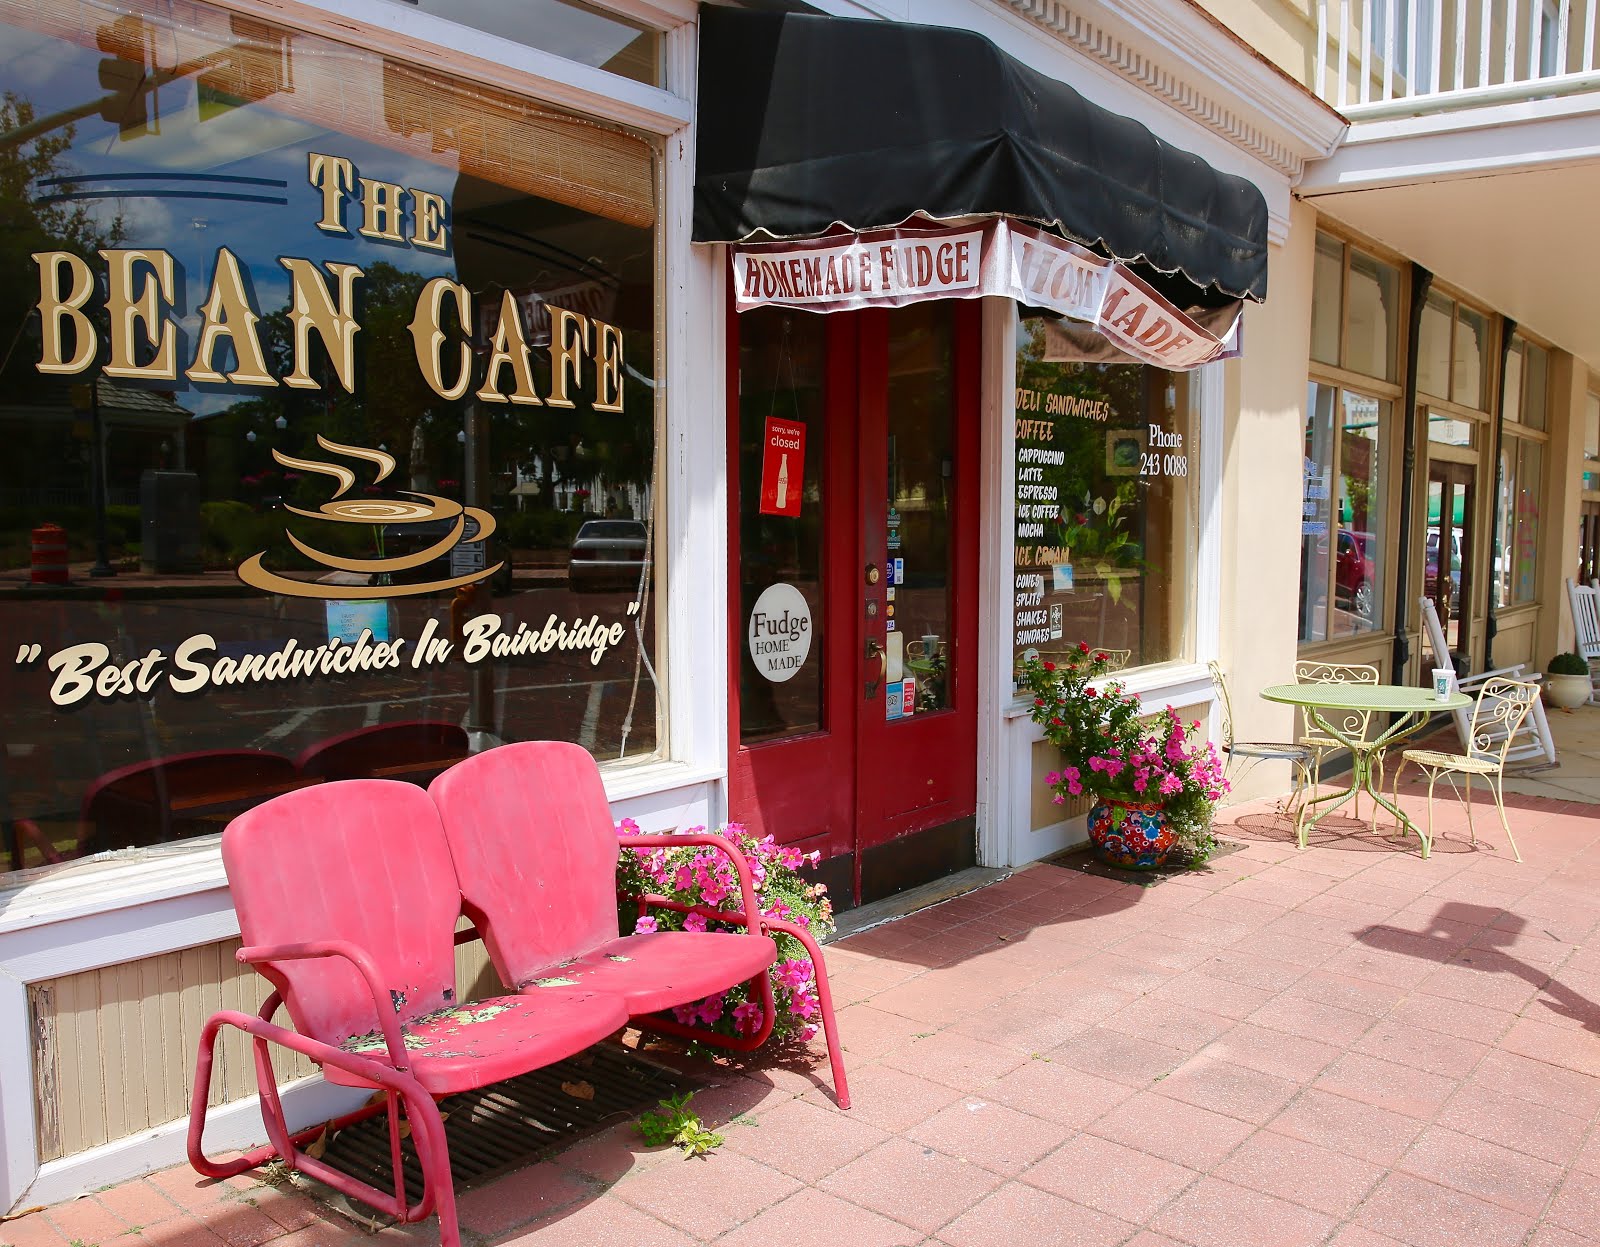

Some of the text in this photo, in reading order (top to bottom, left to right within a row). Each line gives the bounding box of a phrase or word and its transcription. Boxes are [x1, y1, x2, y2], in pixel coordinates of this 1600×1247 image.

[308, 152, 448, 251] THE
[744, 240, 970, 299] HOMEMADE FUDGE
[32, 246, 366, 395] BEAN
[406, 278, 624, 413] CAFE
[1015, 388, 1109, 421] DELI SANDWICHES
[772, 425, 800, 437] sorry, we're
[1015, 419, 1054, 442] COFFEE
[1149, 423, 1183, 448] Phone
[771, 435, 800, 450] closed
[1018, 448, 1065, 465] CAPPUCCINO
[1139, 453, 1188, 477] 243 0088
[1018, 467, 1043, 481] LATTE
[1018, 485, 1058, 501] ESPRESSO
[1018, 504, 1060, 520] ICE COFFEE
[1018, 523, 1044, 538] MOCHA
[1015, 546, 1032, 565] ICE
[1016, 574, 1040, 589] CONES
[1016, 593, 1041, 607] SPLITS
[753, 610, 809, 642] Fudge
[1016, 610, 1048, 627] SHAKES
[1016, 628, 1049, 645] SUNDAES
[169, 633, 402, 688] Sandwiches
[412, 618, 454, 670] In
[755, 639, 790, 655] HOME
[768, 655, 802, 672] MADE
